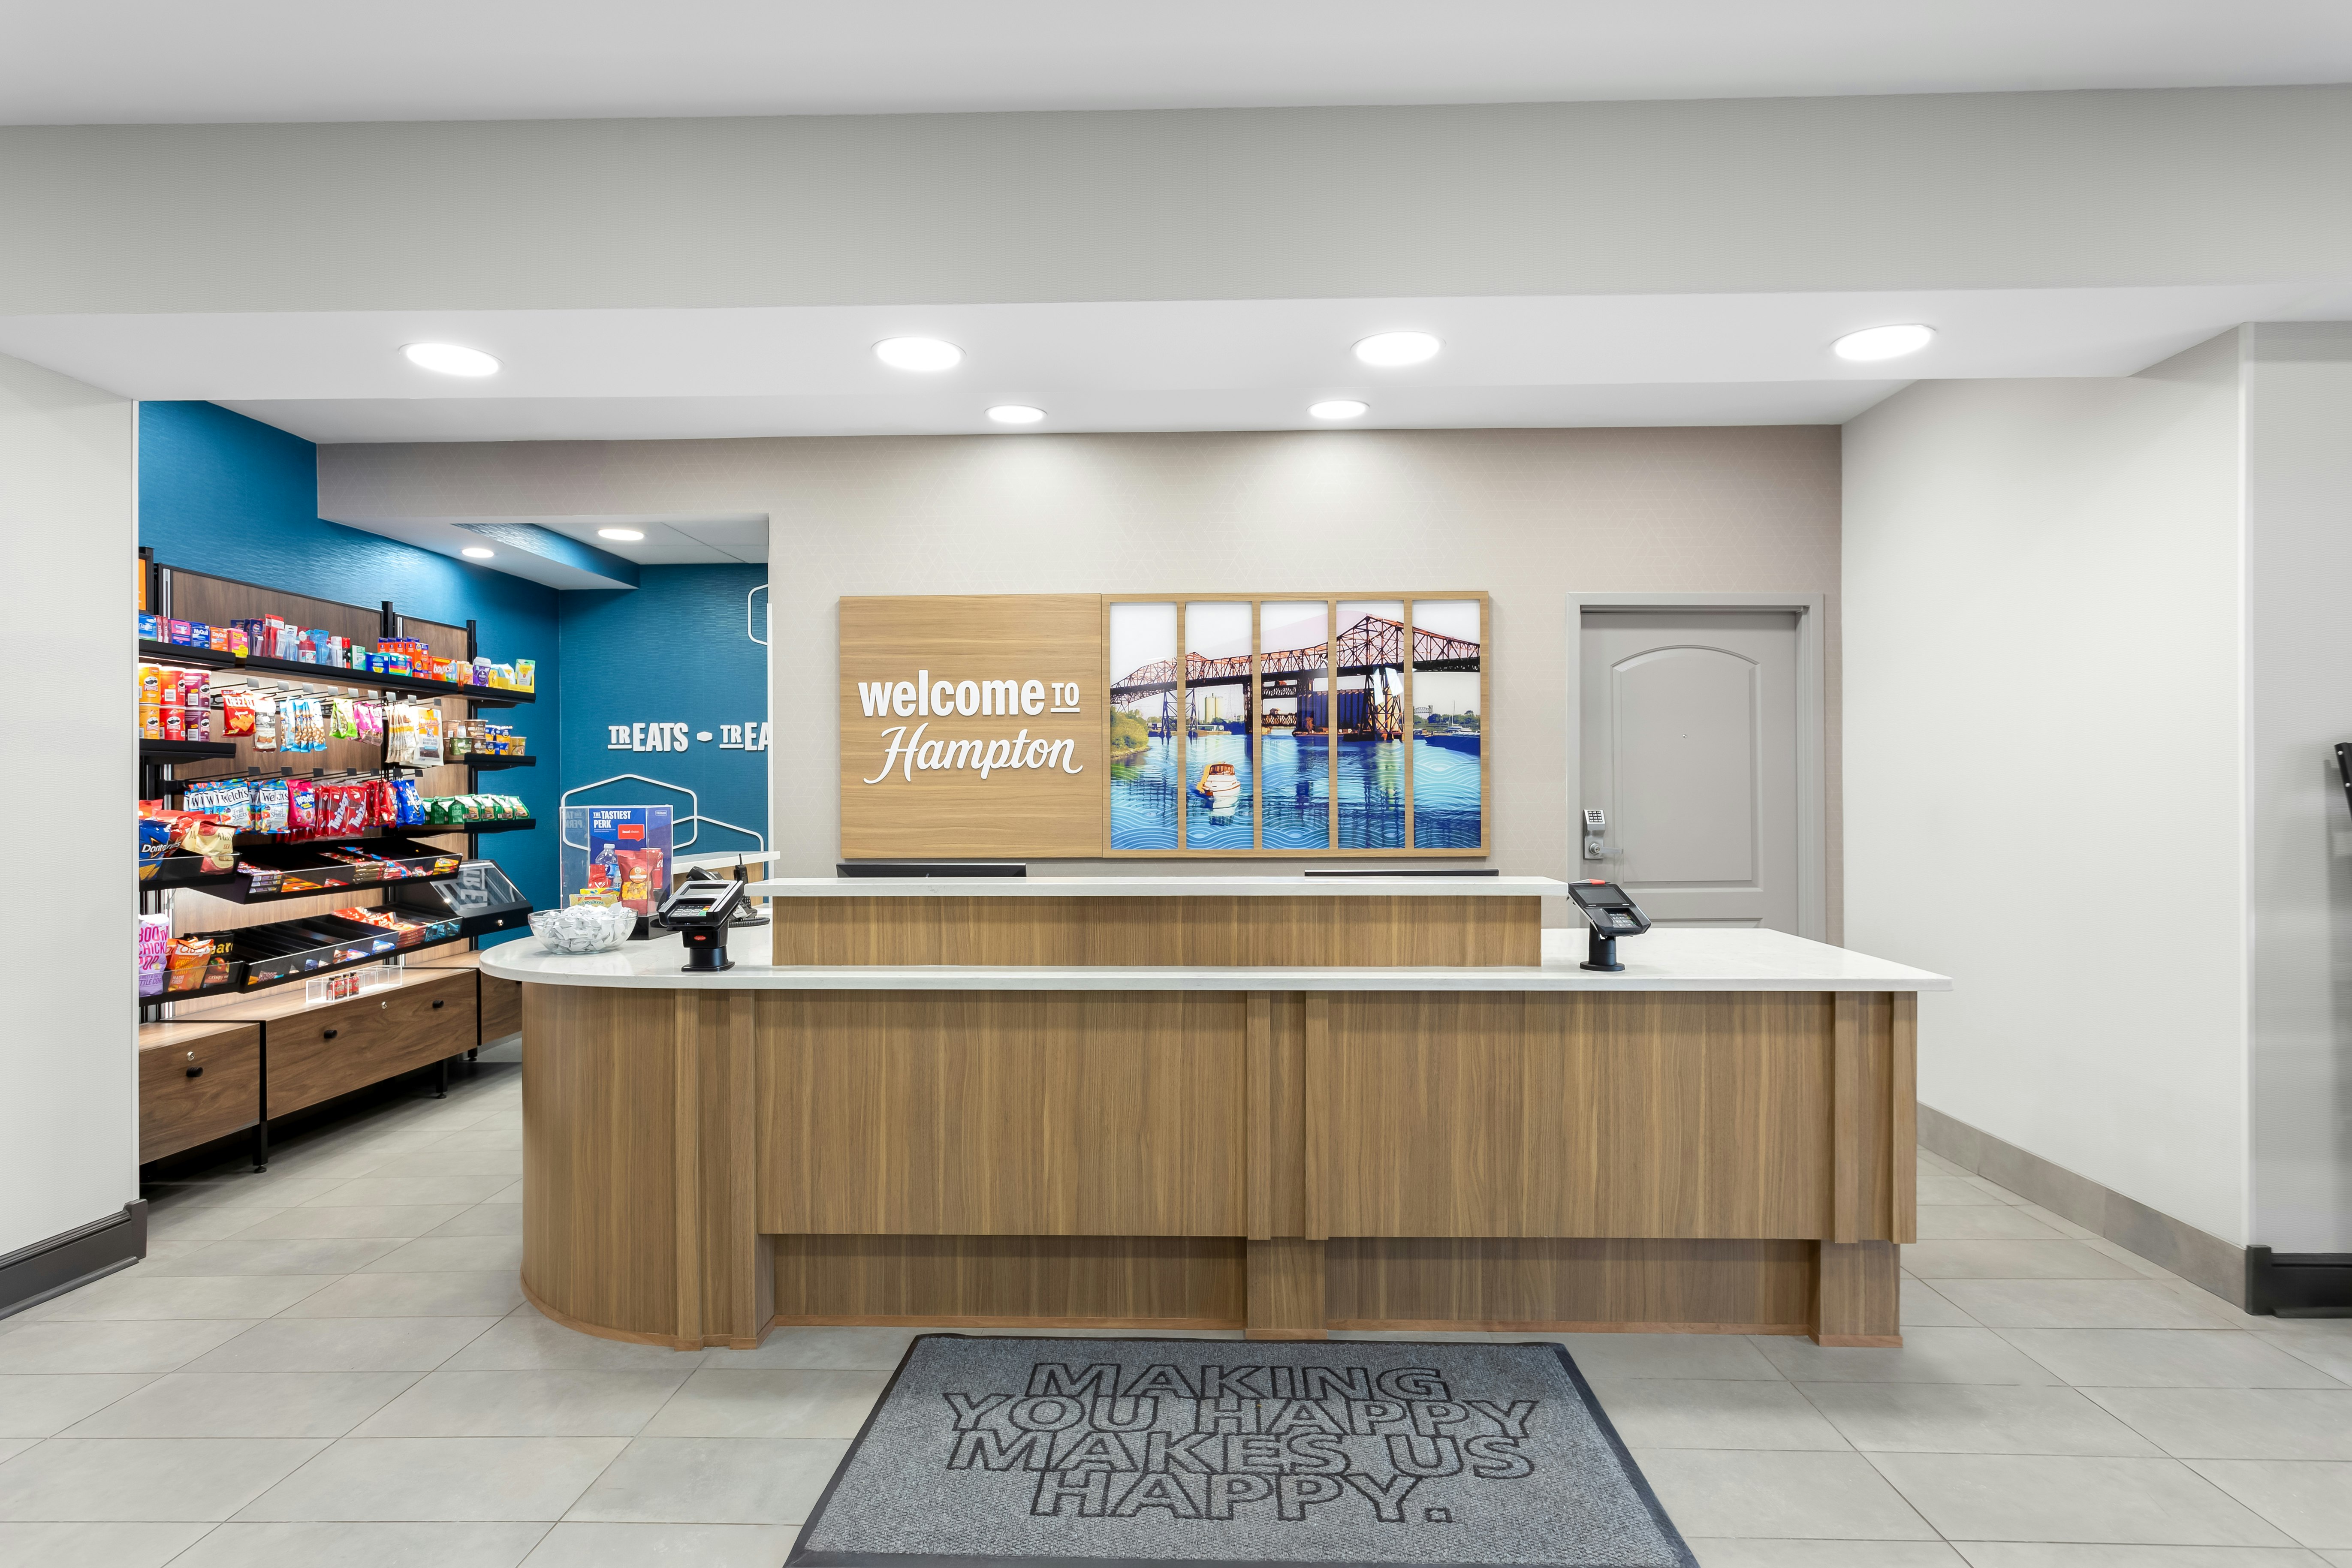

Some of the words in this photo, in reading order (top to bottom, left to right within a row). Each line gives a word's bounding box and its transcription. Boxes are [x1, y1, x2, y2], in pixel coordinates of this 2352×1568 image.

[433, 663, 453, 674] bounce
[857, 669, 1046, 717] welcome
[1051, 682, 1080, 713] TO
[607, 722, 689, 752] TREATS
[719, 722, 768, 751] TREA
[863, 722, 1083, 784] Hampton
[221, 789, 248, 803] Welch's
[594, 820, 612, 828] PERK
[601, 811, 631, 819] TASTIEST
[142, 843, 167, 853] Dorito
[139, 942, 167, 955] CHICK
[1025, 1362, 1453, 1402] MAKING
[943, 1393, 1159, 1433] YOU
[1196, 1396, 1539, 1439] HAPPY
[946, 1429, 1351, 1476] MAKES
[1385, 1434, 1535, 1480] US
[1030, 1469, 1453, 1524] HAPPY.
